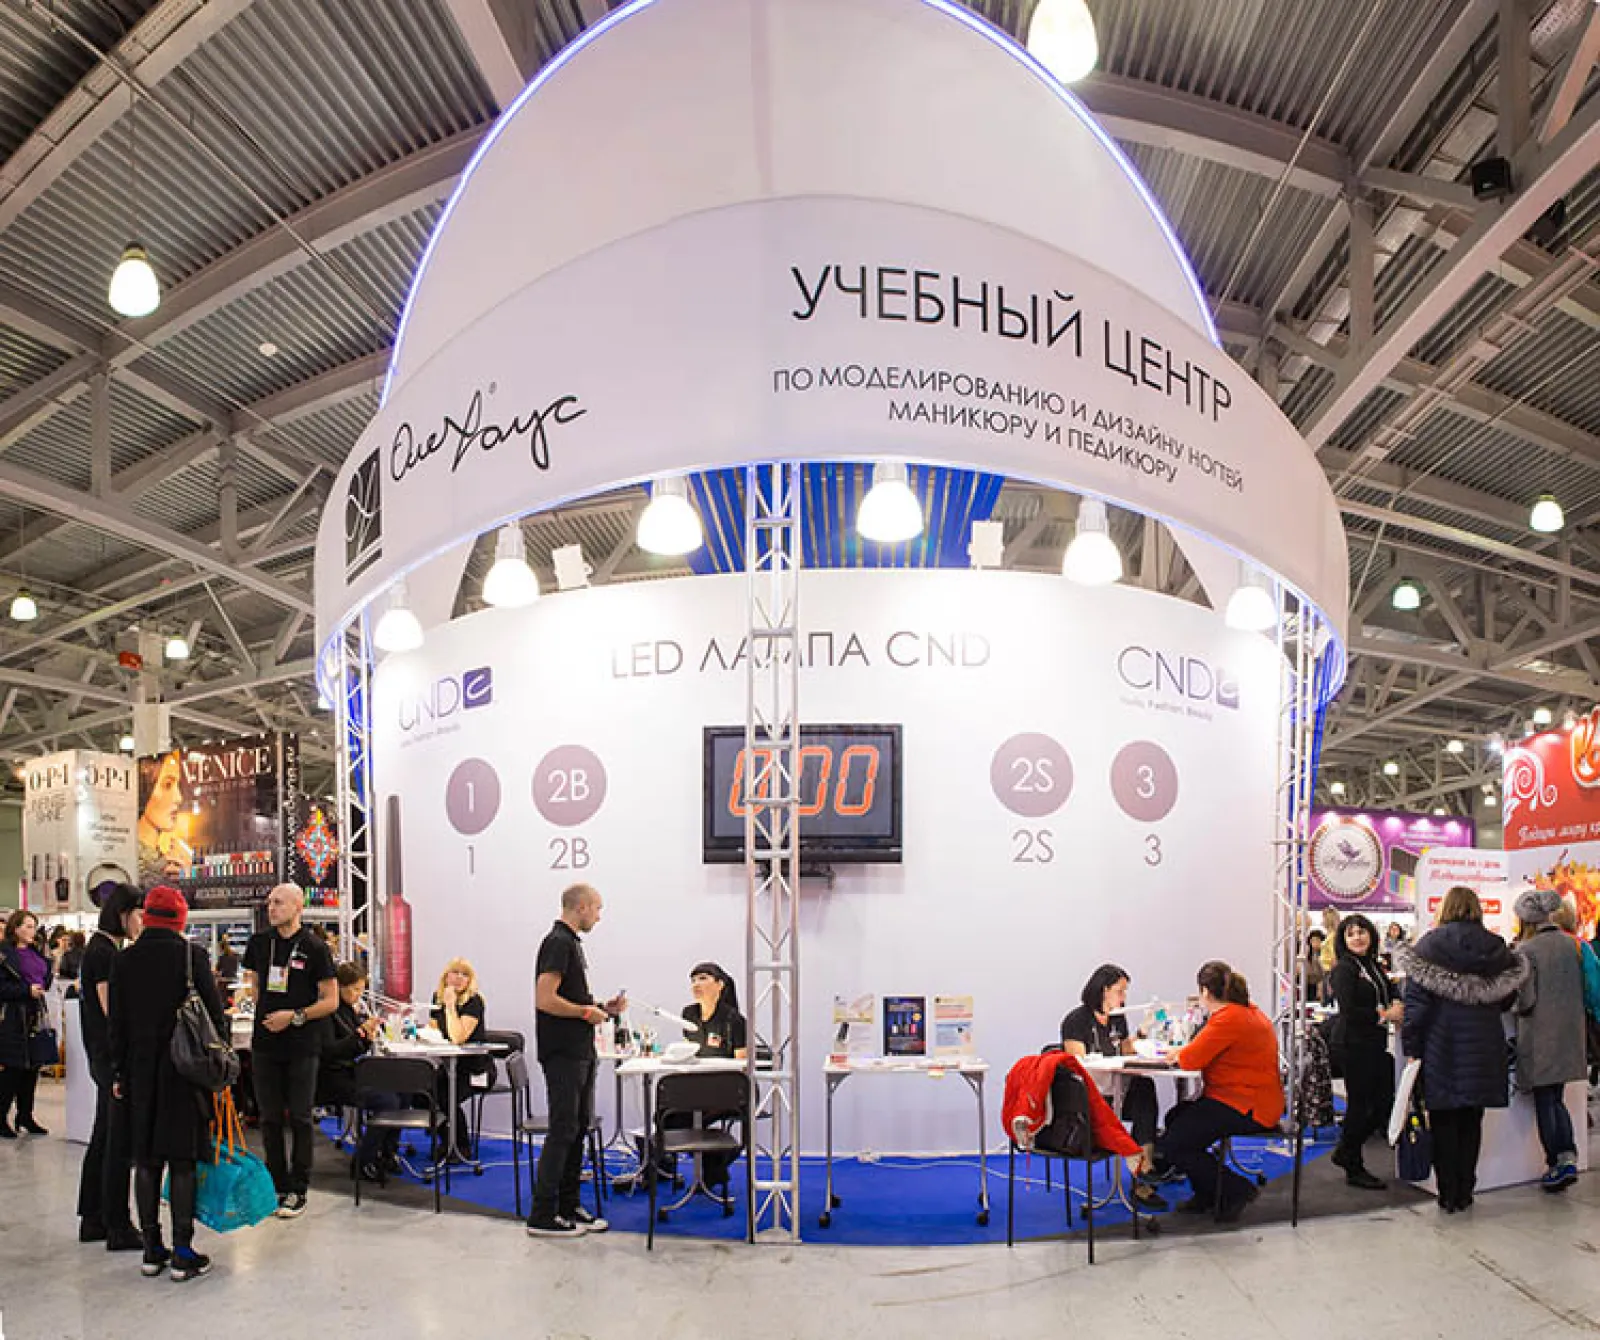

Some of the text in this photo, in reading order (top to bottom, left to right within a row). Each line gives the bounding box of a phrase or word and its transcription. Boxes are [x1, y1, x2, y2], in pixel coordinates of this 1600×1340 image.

[791, 264, 1232, 423] УЧЕБНЫЙ ЦЕНТР
[774, 364, 1245, 493] ПО МОДЕЛИРОВАНИЮ И ДИЗАЙНУ НОГТЕЙ
[888, 399, 1178, 485] МАНИКЮРУ И ПЕДИКЮРУ
[611, 639, 684, 679] LED
[886, 630, 992, 668] CND
[1117, 645, 1214, 701] CND
[183, 747, 272, 785] VENICE
[1010, 756, 1055, 793] 2S
[1135, 764, 1156, 799] 3
[466, 781, 476, 813] 1
[547, 768, 591, 803] 2B
[549, 836, 591, 870] 2B
[1012, 828, 1055, 863] 2S
[1143, 832, 1163, 867] 3
